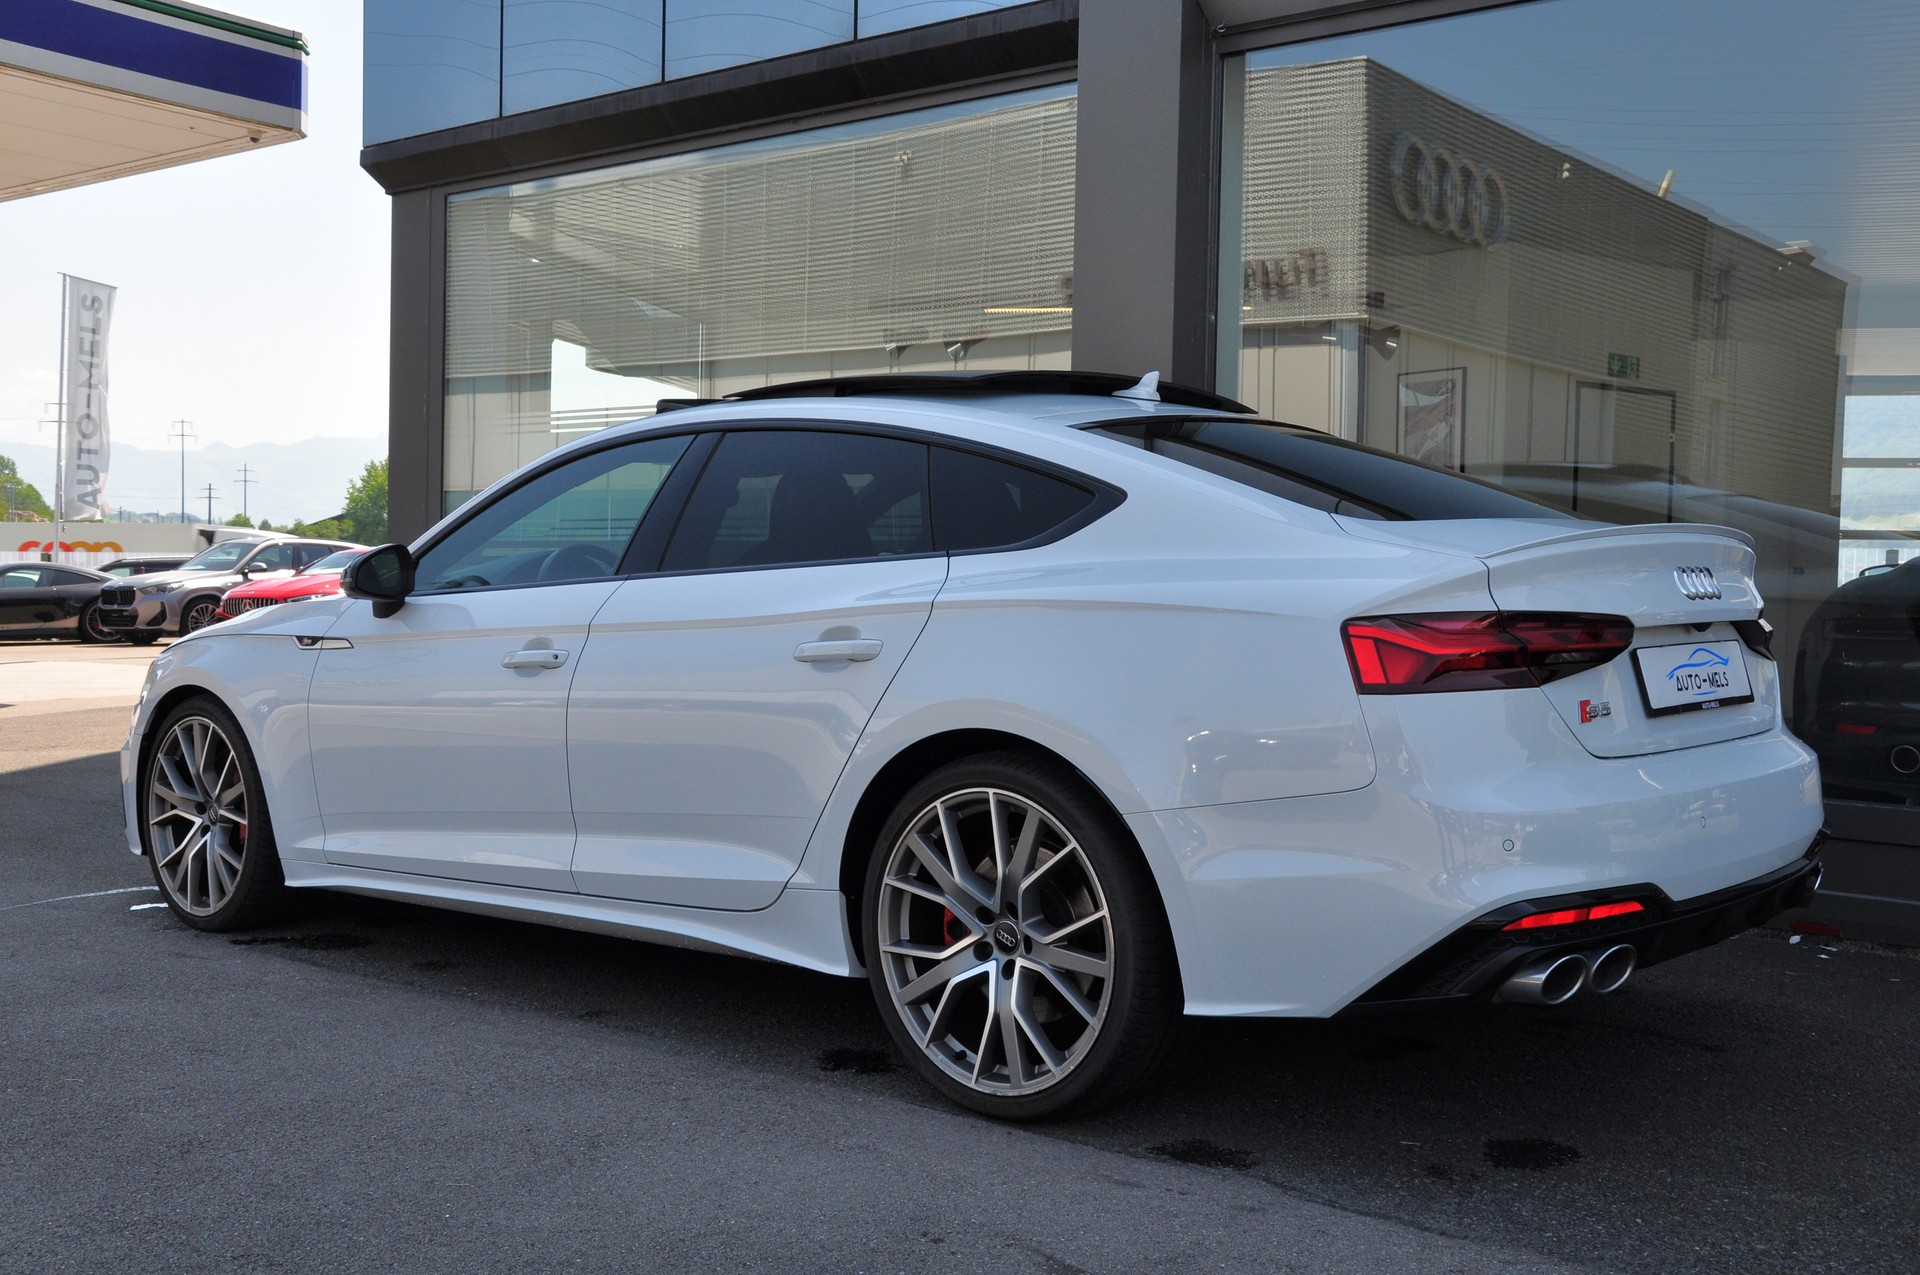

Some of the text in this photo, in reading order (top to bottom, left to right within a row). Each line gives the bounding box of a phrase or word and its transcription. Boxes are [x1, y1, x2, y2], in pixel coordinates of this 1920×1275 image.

[76, 293, 104, 510] AUTO-MELS
[1676, 671, 1729, 691] AUTO-MELS
[1585, 700, 1612, 719] S5
